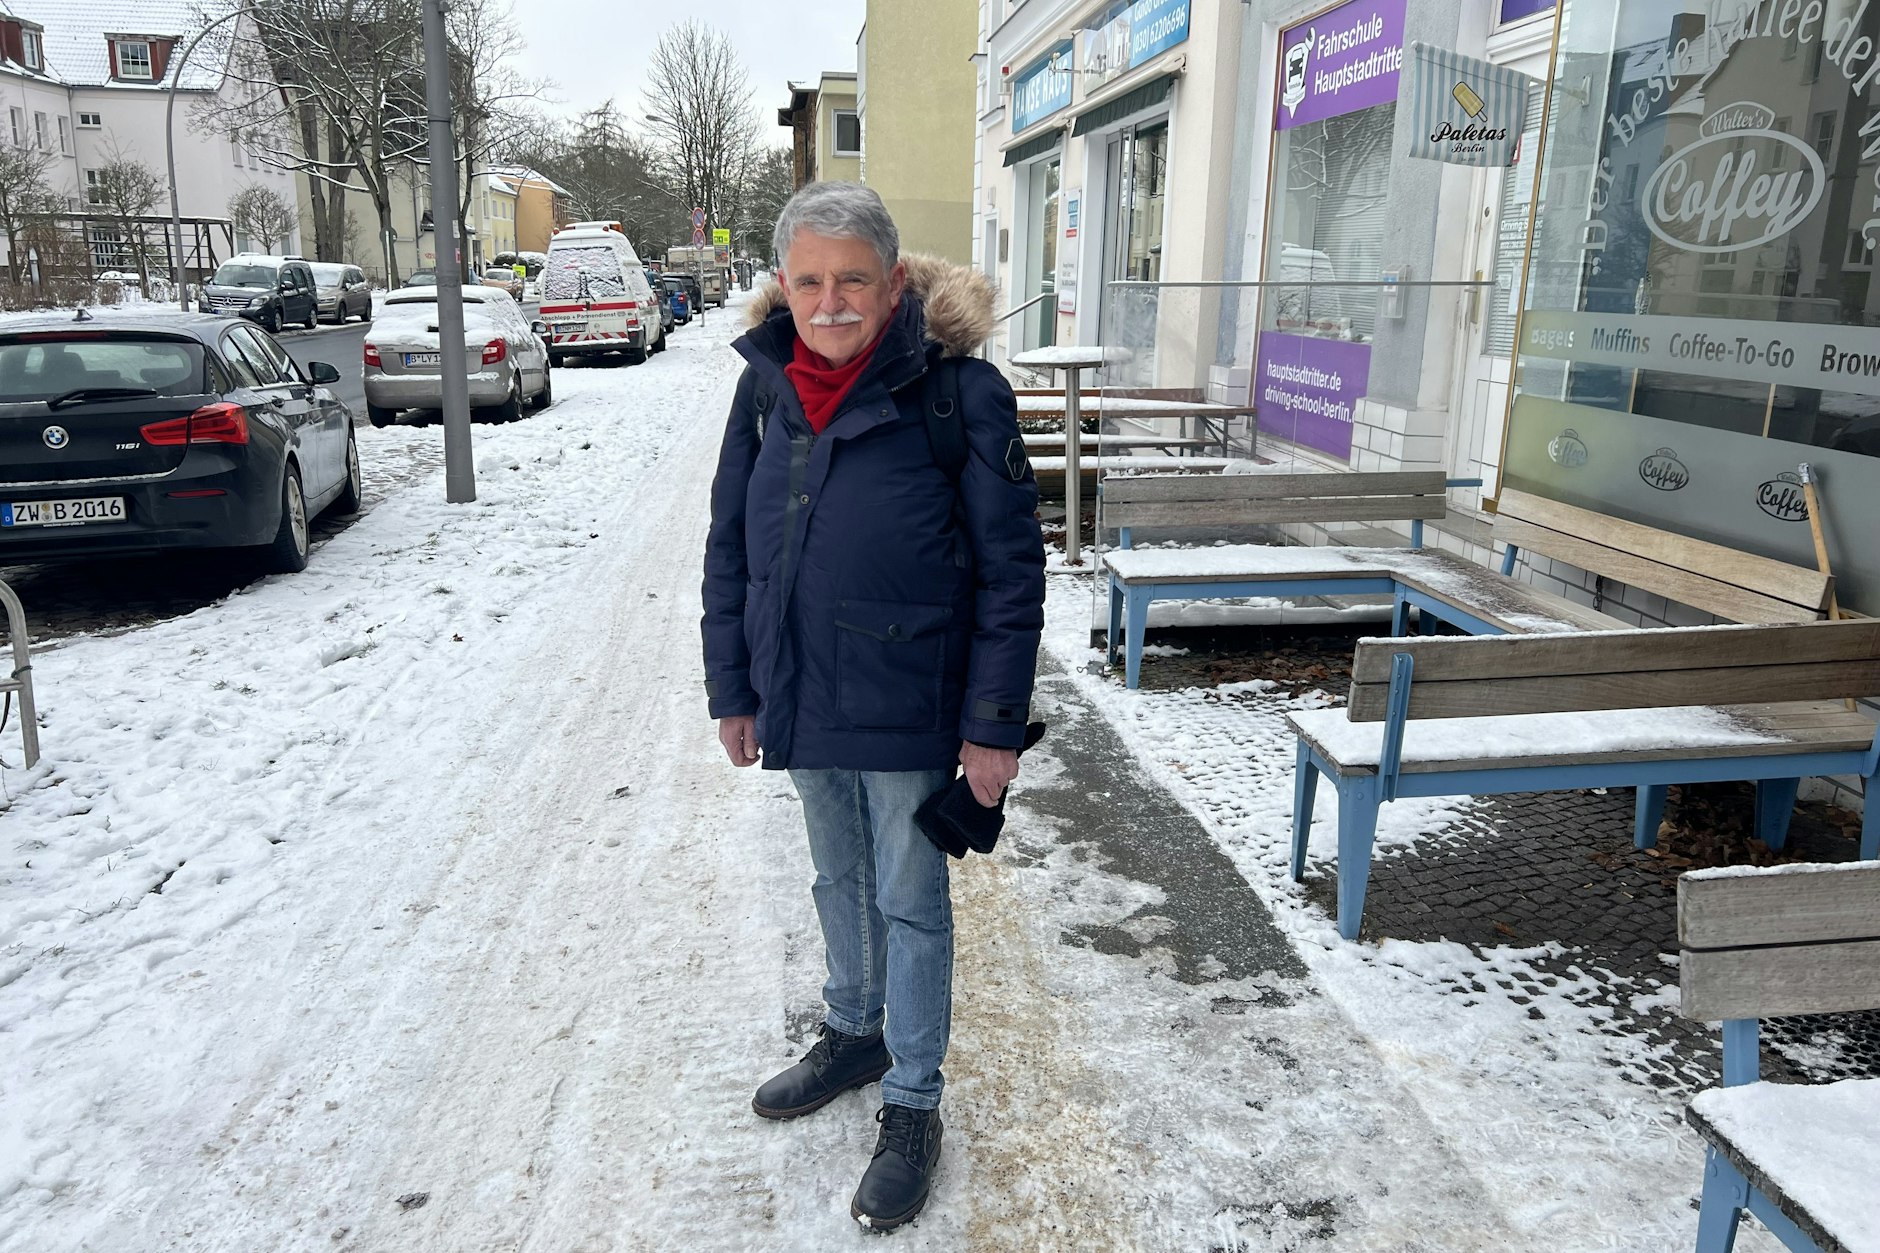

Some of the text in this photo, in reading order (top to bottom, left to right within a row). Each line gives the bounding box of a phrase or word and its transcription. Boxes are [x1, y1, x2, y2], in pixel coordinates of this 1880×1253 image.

[1132, 25, 1150, 59] (030)
[1149, 4, 1186, 45] 62206696
[1317, 12, 1383, 60] Fahrschule
[1015, 58, 1068, 121] HANSE HAUS
[1607, 37, 1693, 148] beste
[1430, 121, 1507, 143] Paletas
[1451, 142, 1486, 154] Berlin
[1655, 149, 1805, 243] Coffey
[541, 313, 571, 321] Abschlepp
[421, 355, 433, 363] LY
[1531, 327, 1574, 351] Bagels
[1590, 327, 1651, 355] Muffins
[1668, 332, 1795, 369] Coffee-To-Go
[1266, 359, 1342, 392] hauptstadtritter.de
[1643, 457, 1685, 488] Coffey
[14, 499, 121, 522] ZW B 2016
